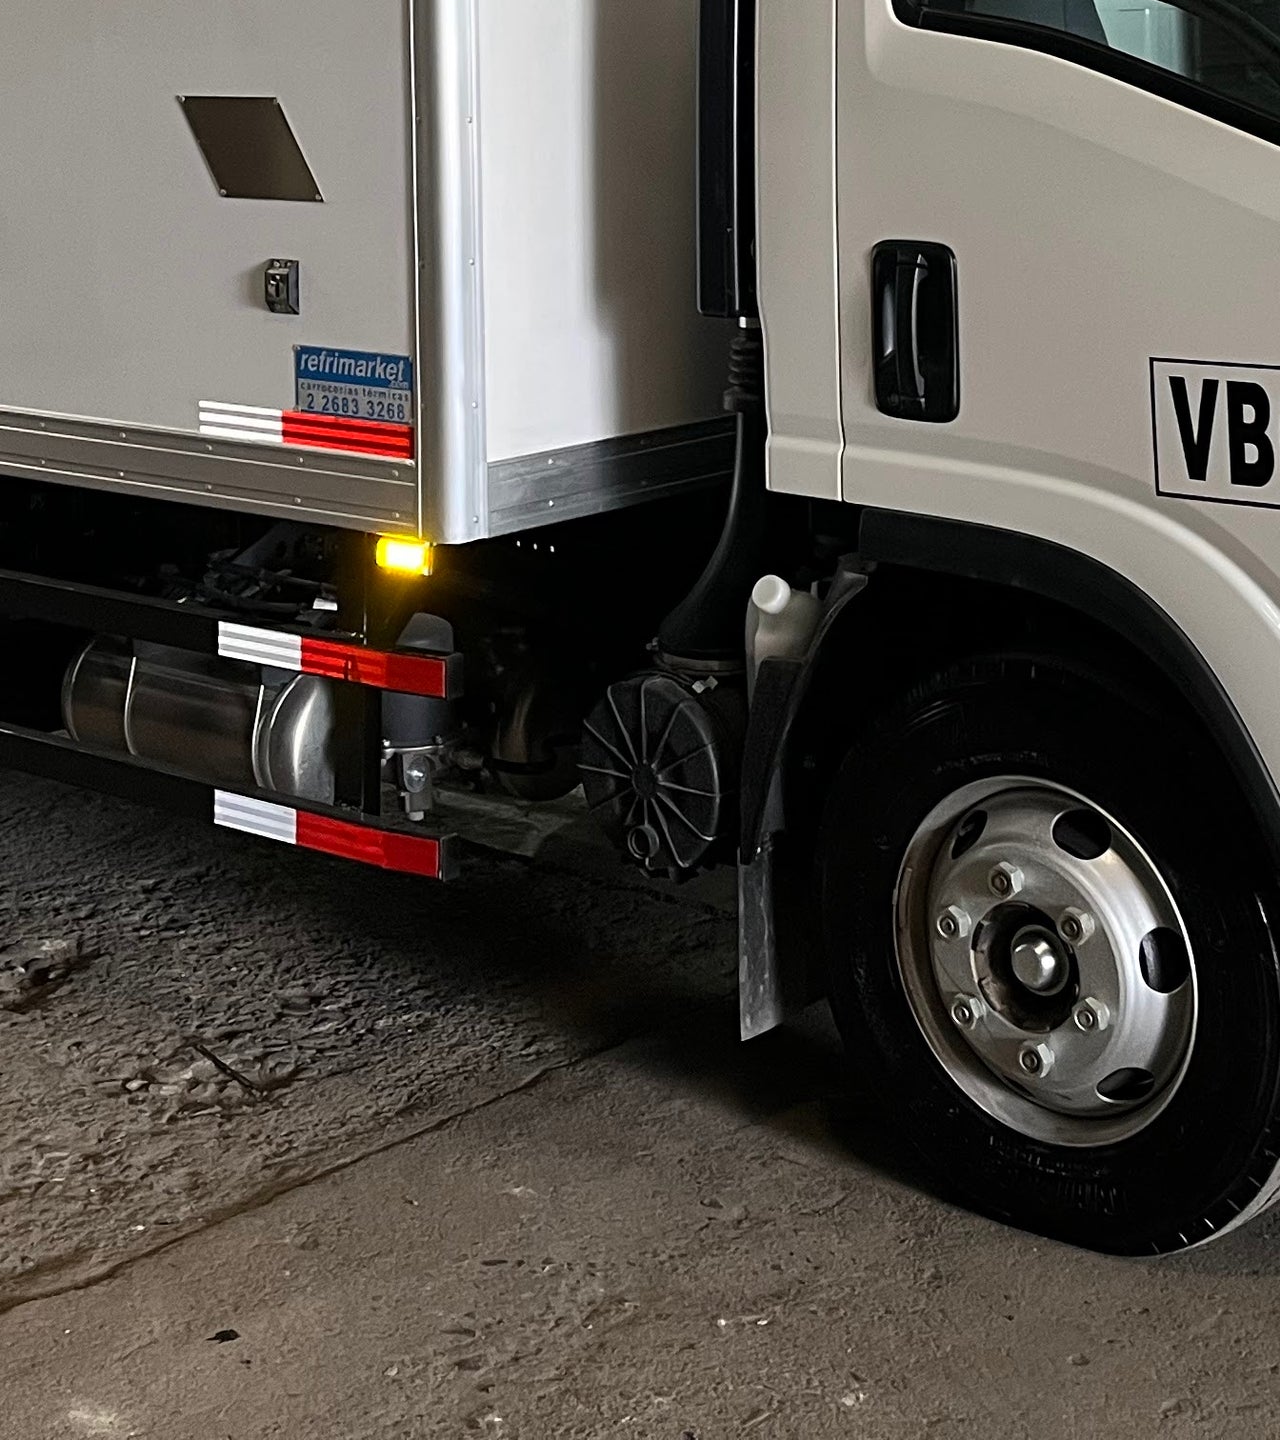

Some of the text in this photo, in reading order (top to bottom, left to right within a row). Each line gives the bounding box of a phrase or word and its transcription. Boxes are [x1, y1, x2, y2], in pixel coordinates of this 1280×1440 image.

[300, 351, 405, 381] refrimarket
[306, 393, 406, 420] 2 2683 3268
